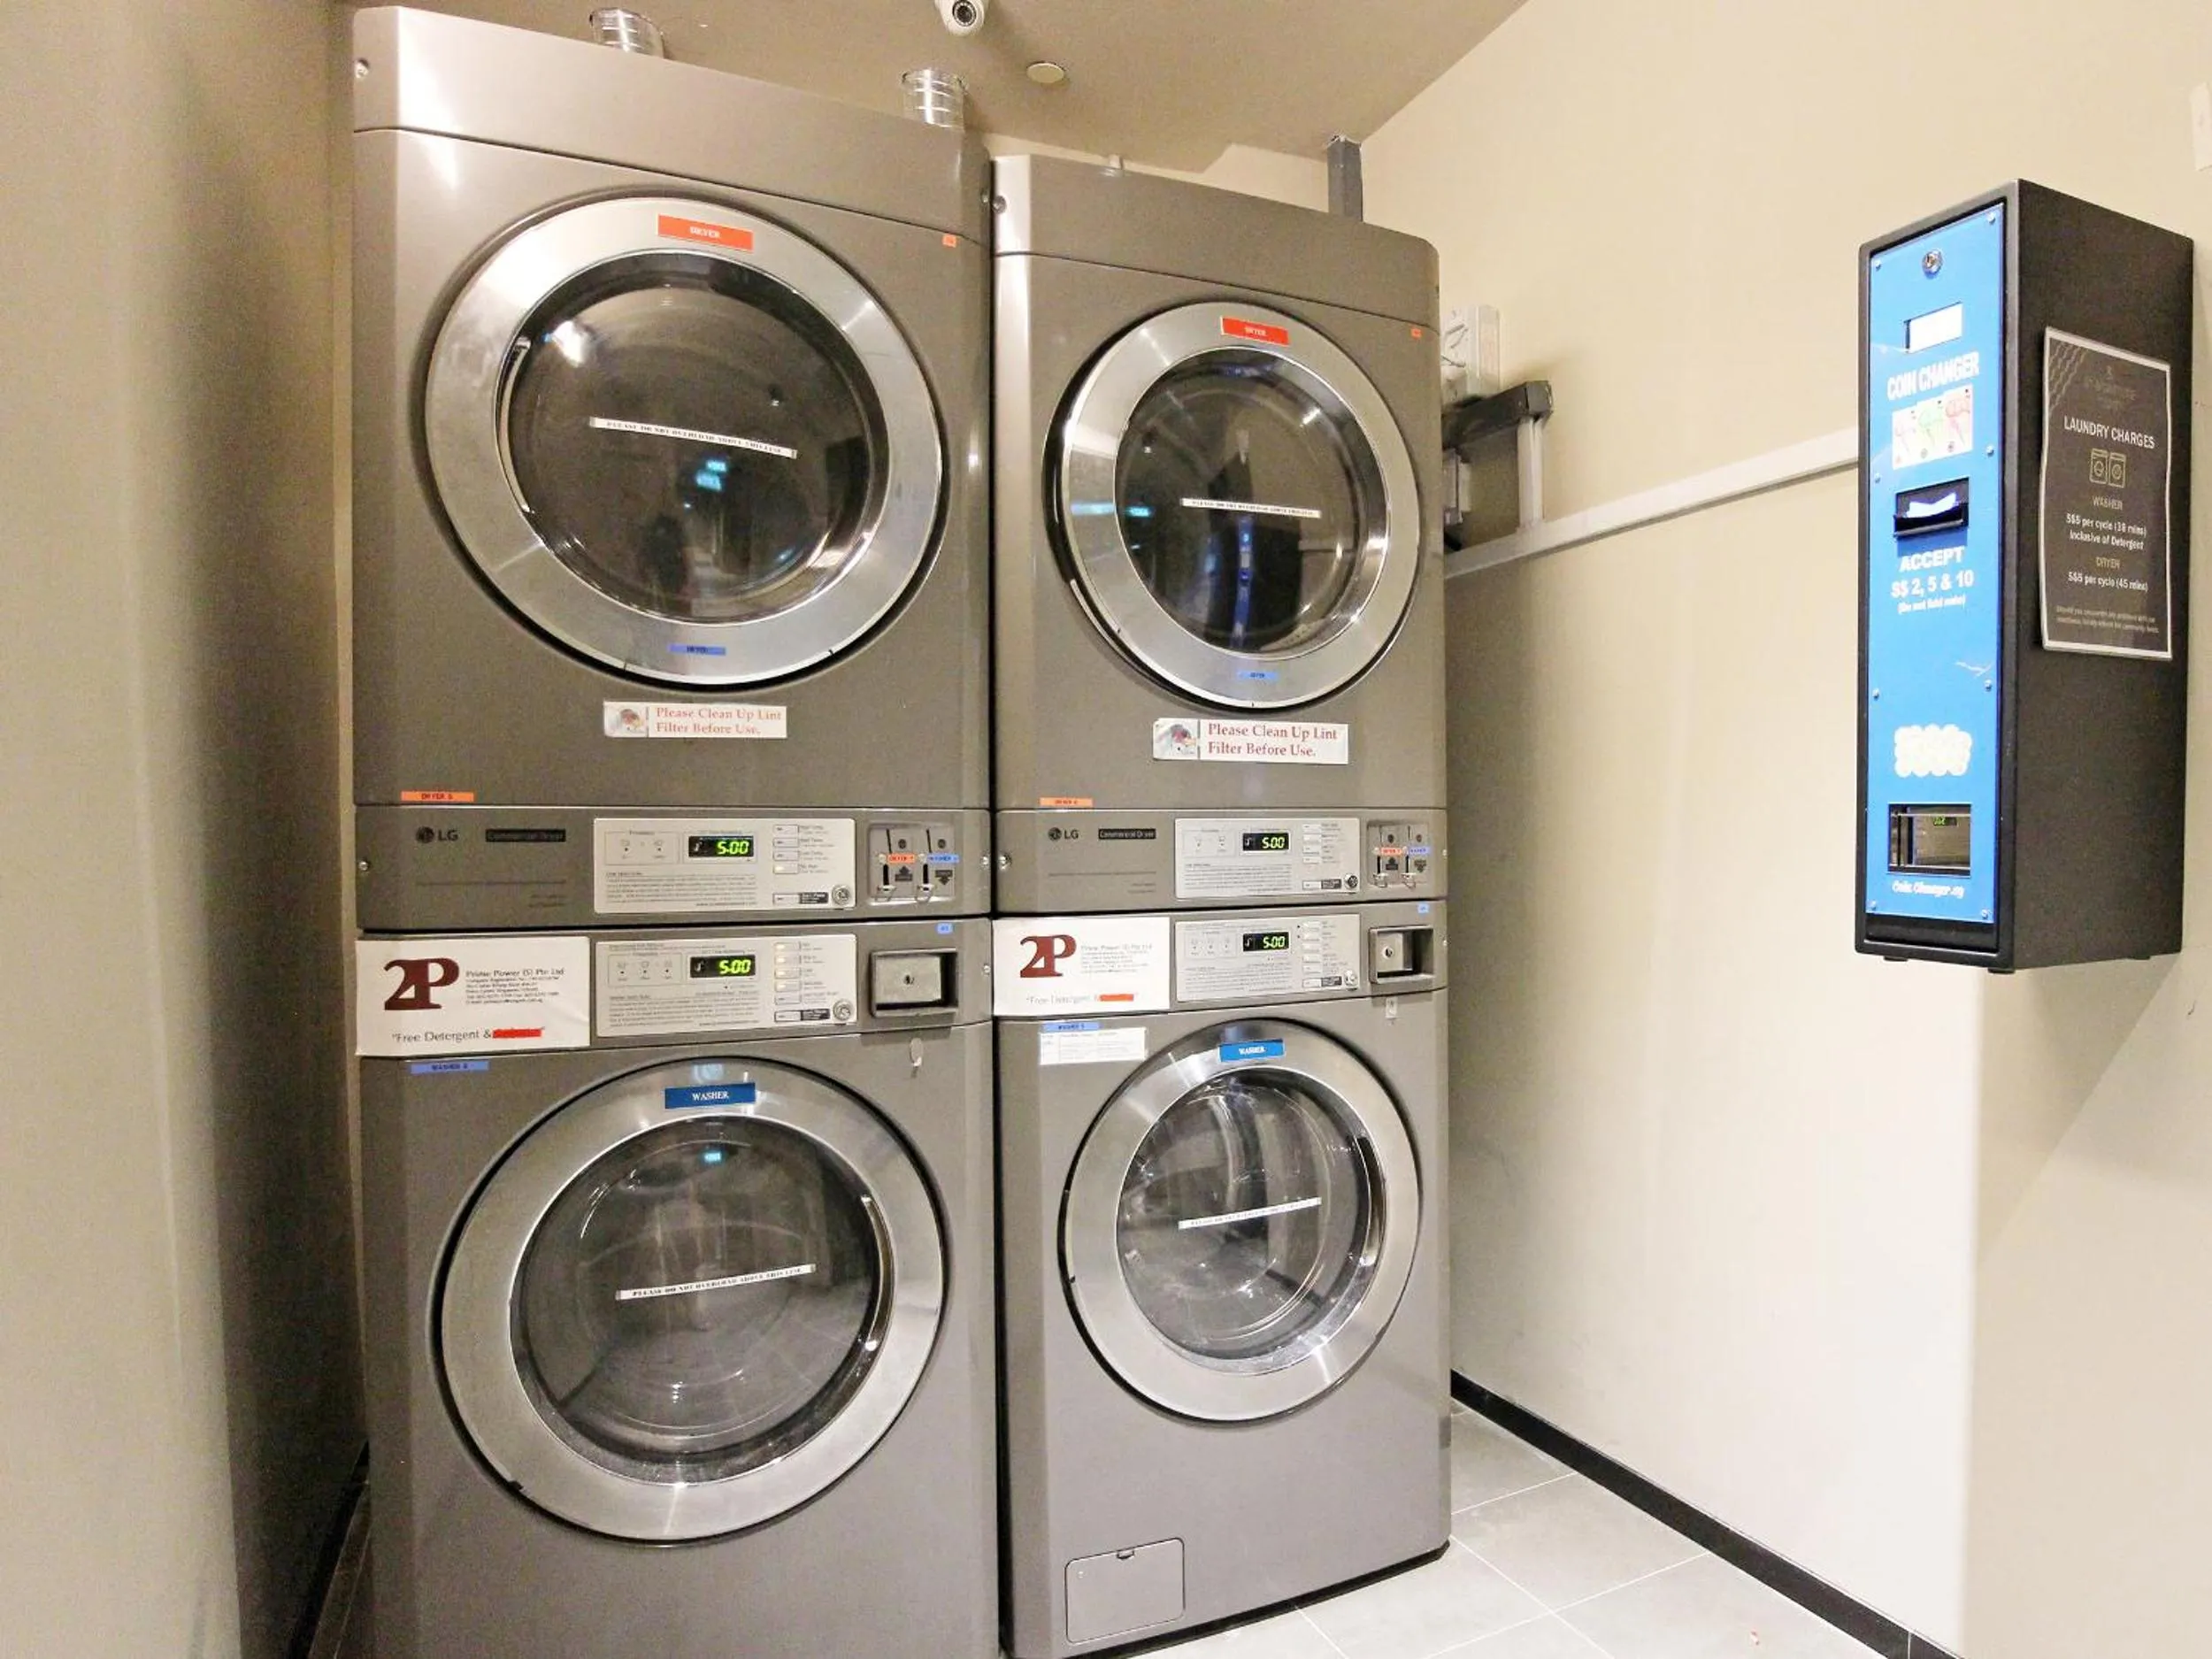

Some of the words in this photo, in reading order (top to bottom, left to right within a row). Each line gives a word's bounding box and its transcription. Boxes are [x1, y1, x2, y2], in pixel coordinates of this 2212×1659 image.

[1886, 369, 1918, 401] COIN
[1918, 350, 1980, 391] CHANGER
[2064, 415, 2109, 439] LAUNDRY
[2111, 426, 2155, 449] CHARGES
[2092, 493, 2124, 511] WASHER
[2081, 518, 2094, 528] per
[2094, 519, 2113, 532] cycle
[2070, 529, 2101, 544] Inclusive
[2101, 534, 2110, 545] of
[2111, 535, 2145, 551] Detergent
[1898, 545, 1966, 573] ACCEPT
[1911, 577, 1925, 598] 2,
[1927, 575, 1938, 593] 5
[1955, 569, 1975, 588] 10
[2084, 575, 2097, 586] per
[2097, 576, 2116, 588] cycle
[657, 707, 694, 718] Please
[697, 708, 733, 719] Clean
[736, 709, 755, 723] Up
[757, 710, 782, 721] Lint
[657, 722, 688, 733] Filter
[693, 723, 733, 734] Before
[735, 724, 762, 735] Use.
[1208, 723, 1249, 736] Please
[1252, 724, 1288, 738] Clean
[1292, 726, 1310, 741] Up
[1313, 727, 1338, 740] Lint
[1208, 741, 1242, 754] Filter
[1246, 742, 1287, 756] Before
[1290, 743, 1317, 757] Use.
[437, 829, 459, 841] LG
[1064, 829, 1079, 841] LG
[1019, 934, 1078, 979] 2P
[383, 957, 460, 1011] 2P
[424, 1029, 480, 1044] Detergent
[482, 1029, 492, 1039] &
[692, 1090, 730, 1102] WASHER
